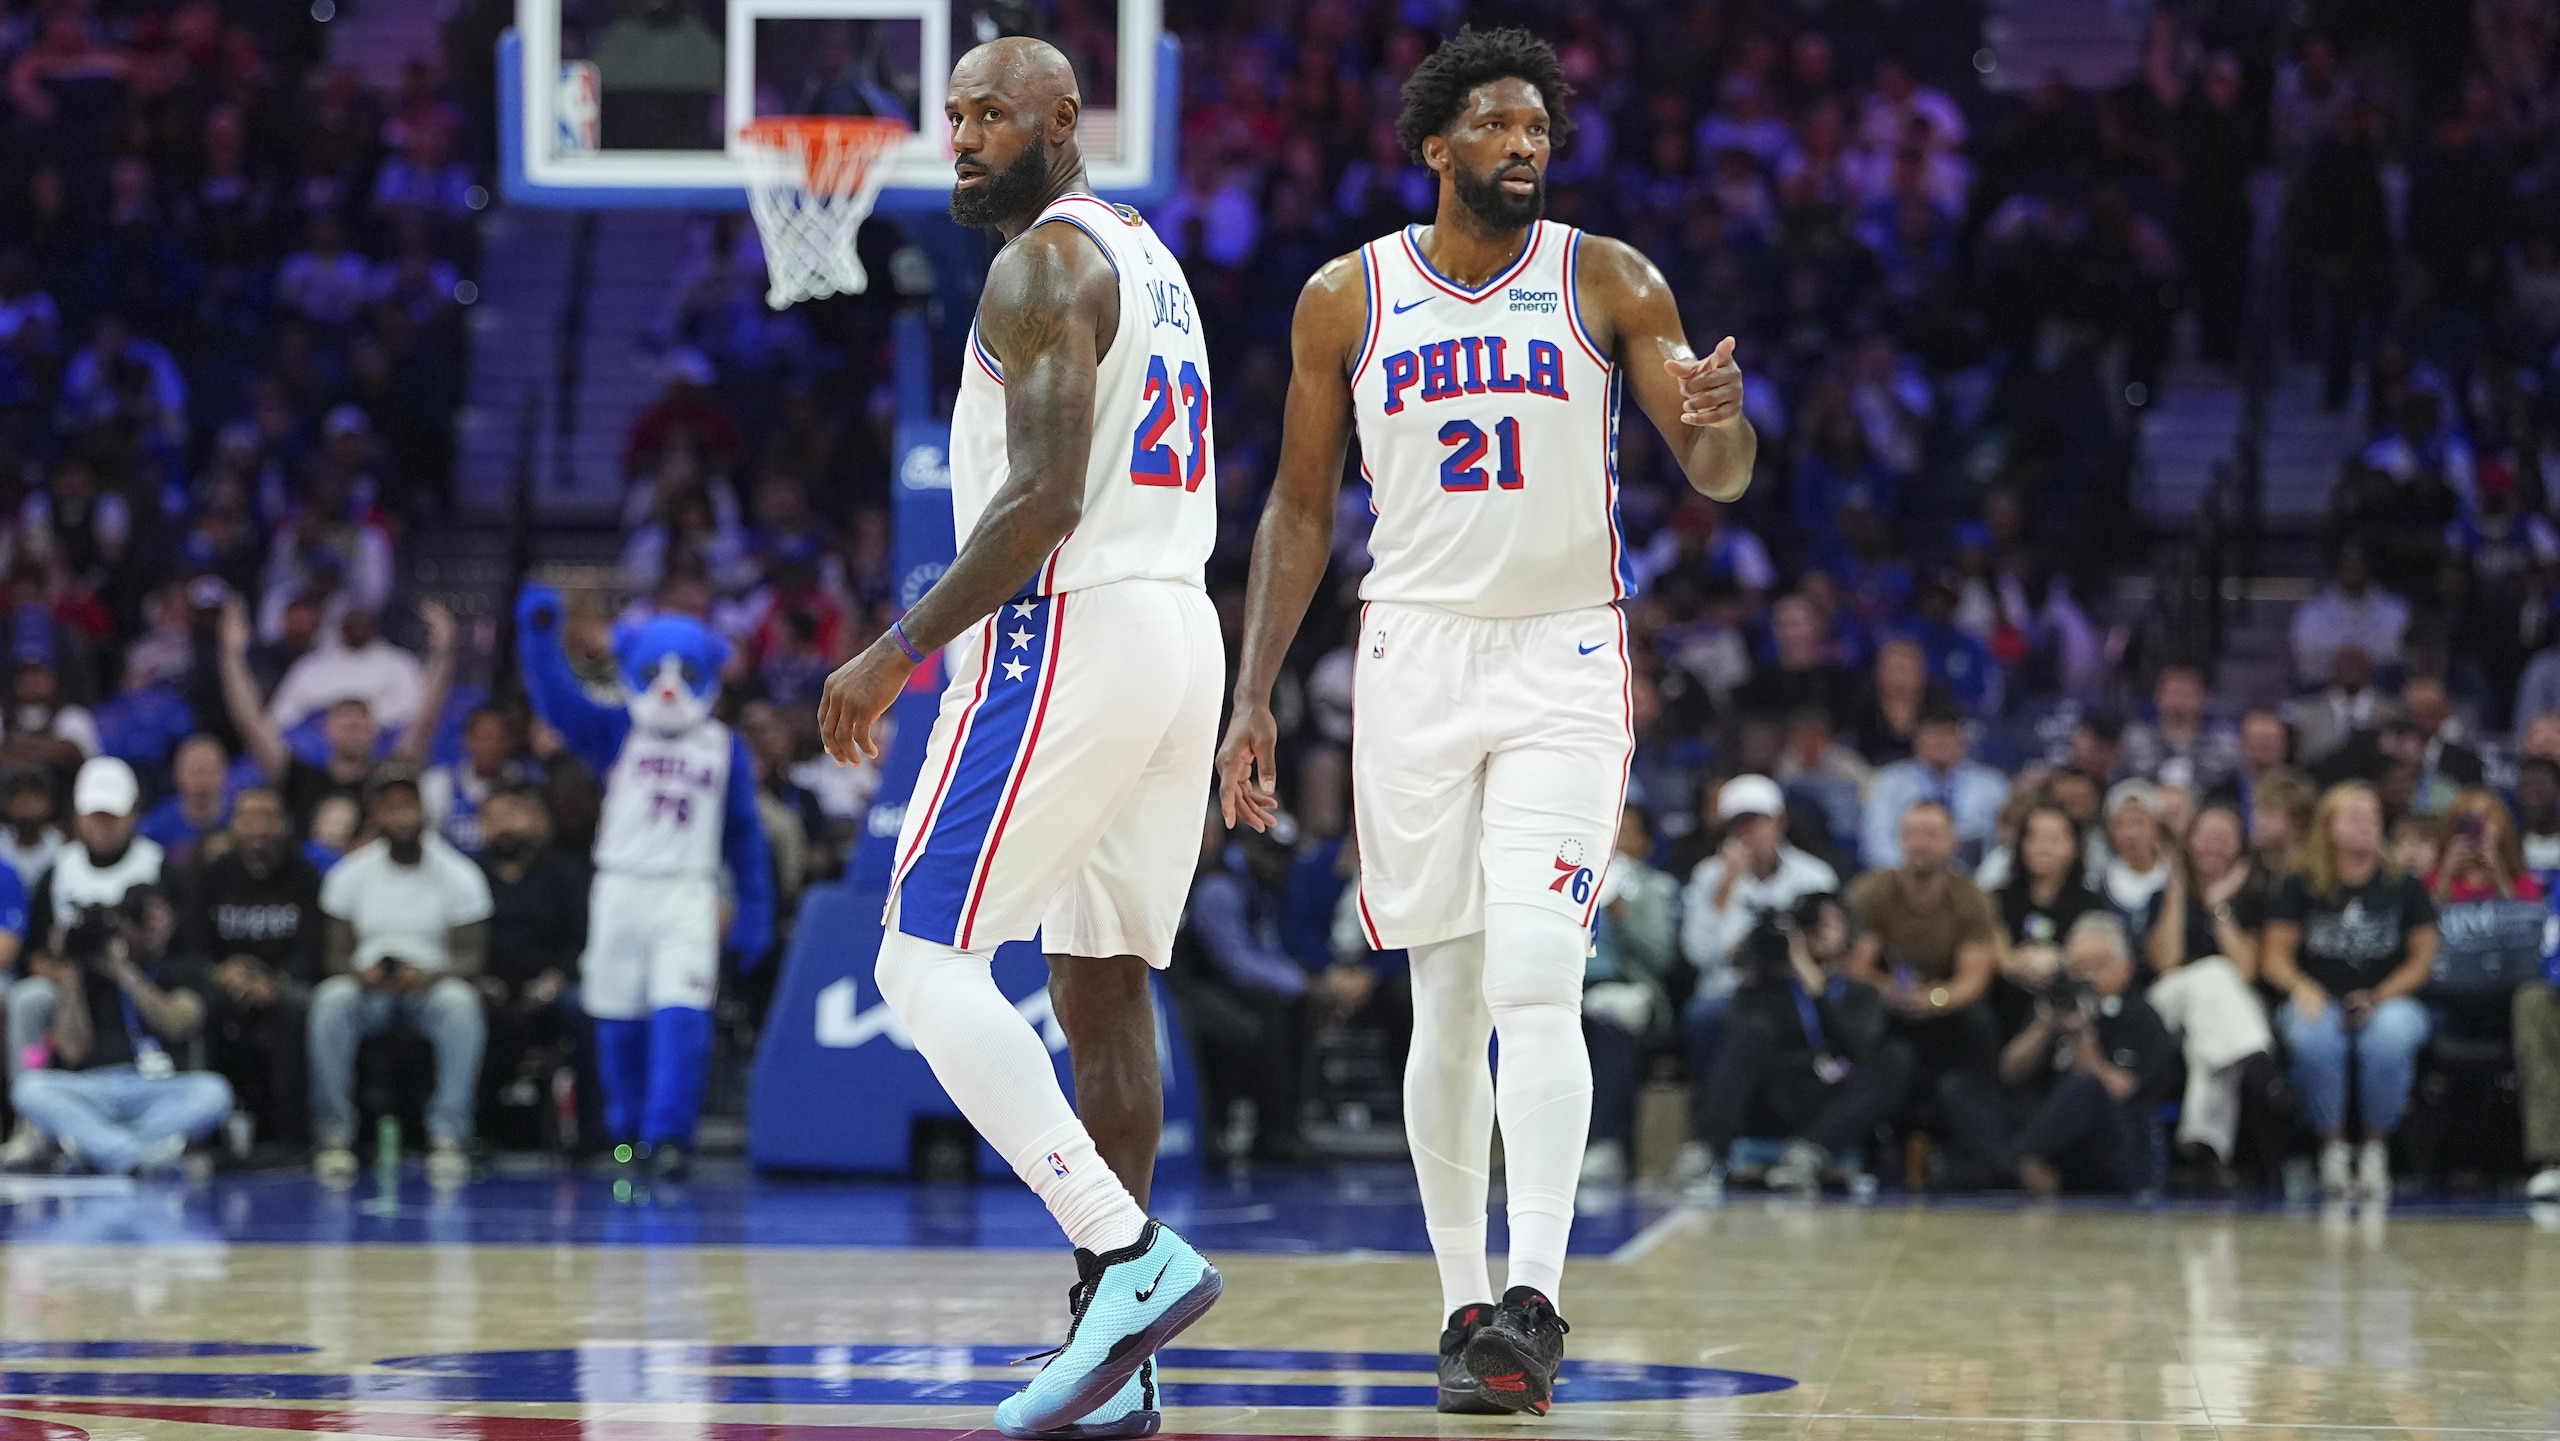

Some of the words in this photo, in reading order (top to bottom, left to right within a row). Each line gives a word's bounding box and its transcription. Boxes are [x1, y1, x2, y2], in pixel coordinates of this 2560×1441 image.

[1146, 278, 1190, 335] JMES
[1509, 288, 1558, 301] Bloom
[1509, 302, 1558, 314] energy
[1382, 336, 1569, 416] PHILA
[1130, 354, 1209, 493] 23
[1438, 416, 1524, 493] 21
[1549, 855, 1593, 905] 76
